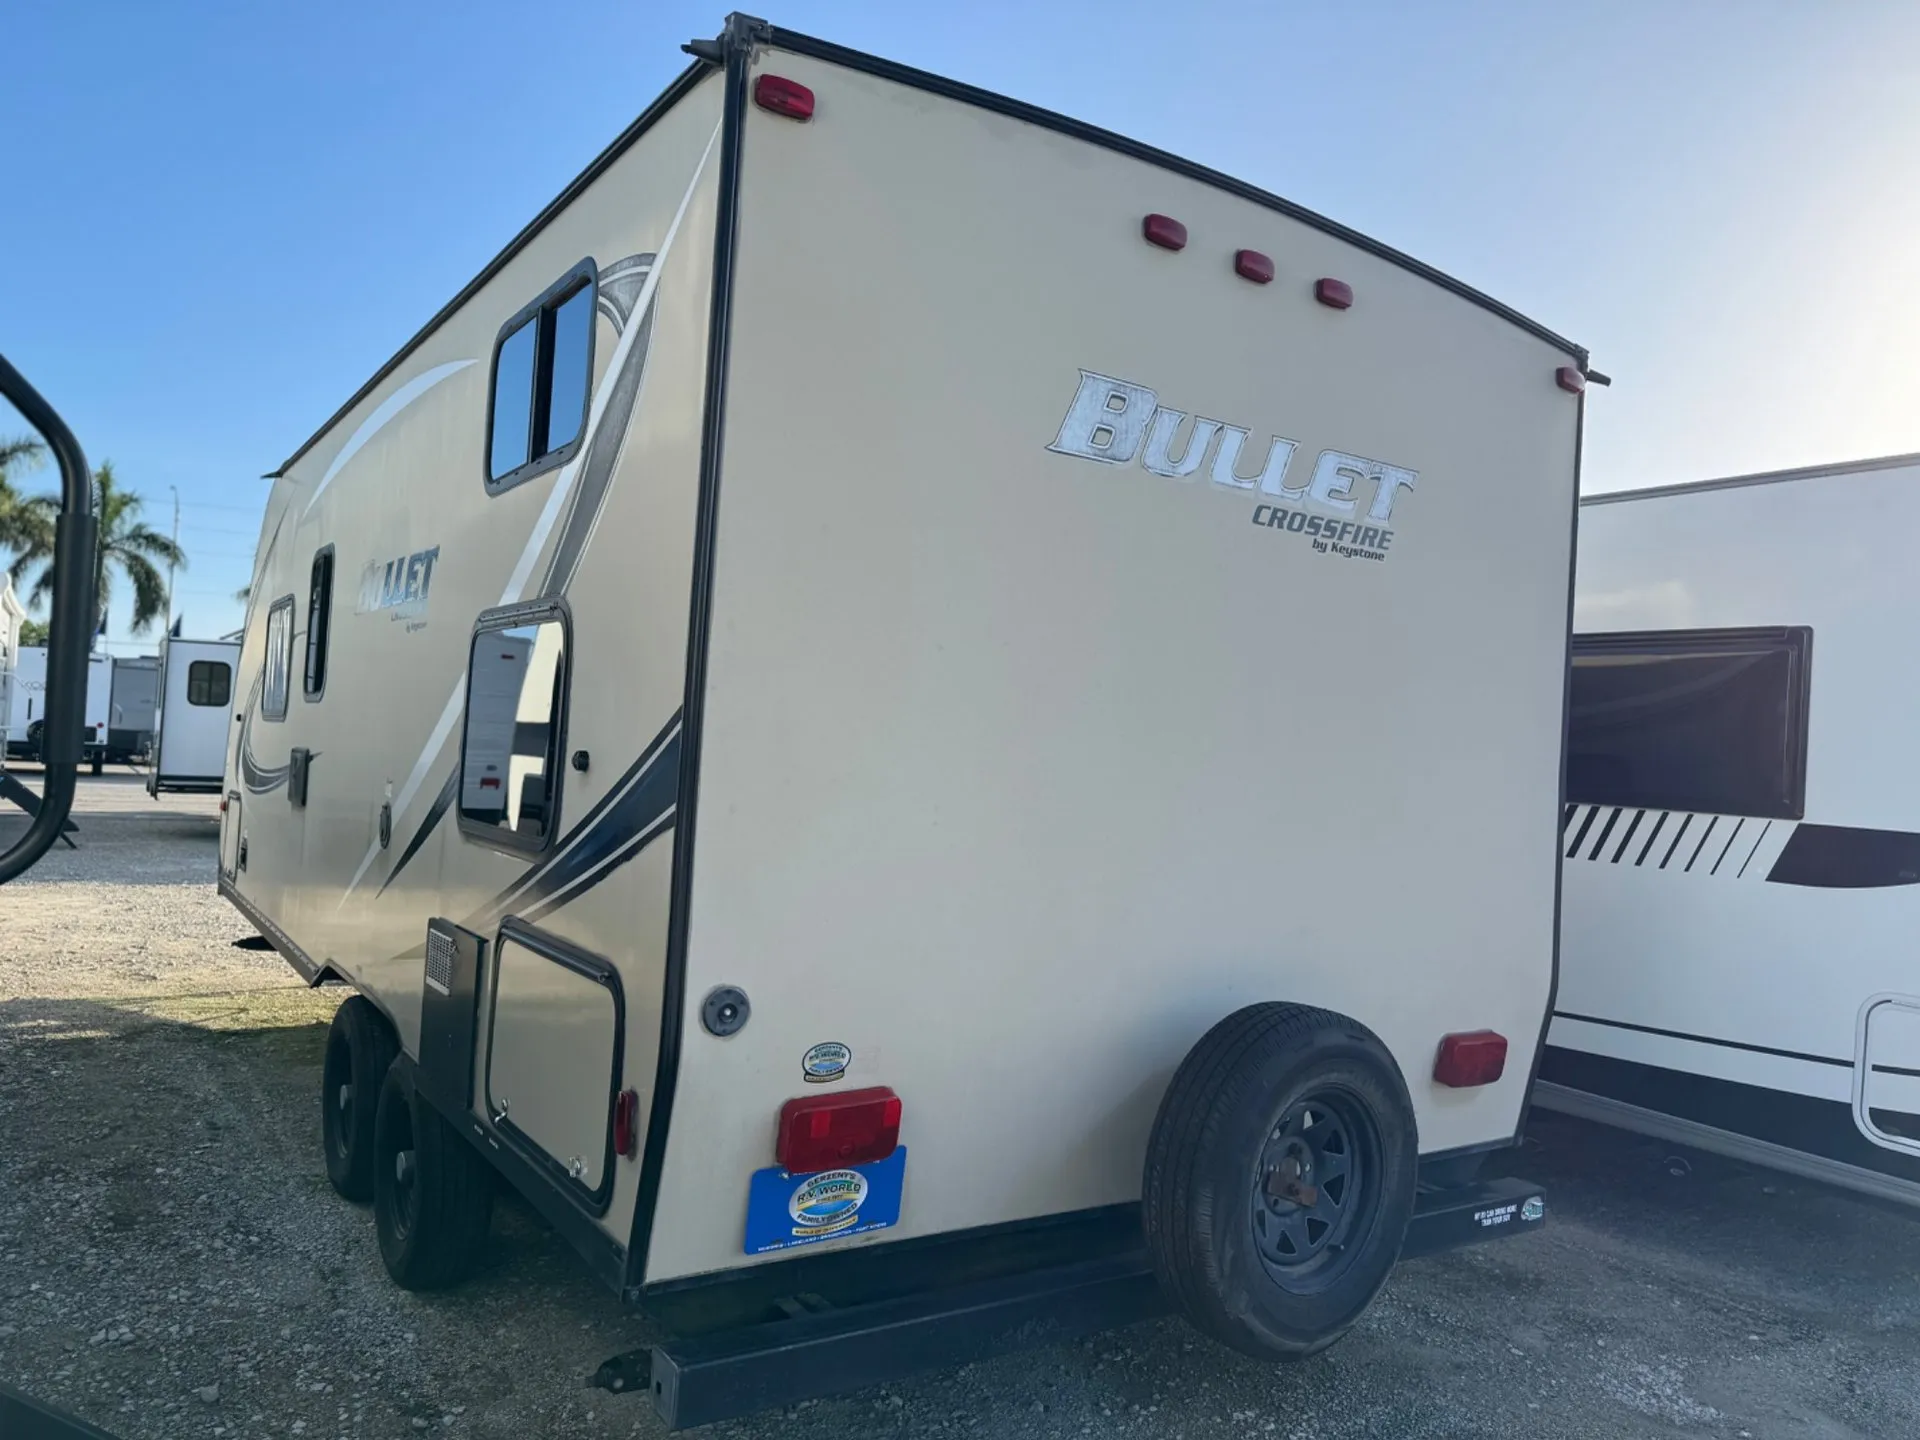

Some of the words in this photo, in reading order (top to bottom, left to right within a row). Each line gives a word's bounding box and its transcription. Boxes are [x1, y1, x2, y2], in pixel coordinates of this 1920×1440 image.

[1044, 368, 1420, 523] BULLET
[1252, 504, 1394, 550] CROSSFIRE
[1312, 538, 1328, 553] by
[1330, 541, 1385, 561] Keystone
[819, 1183, 862, 1195] WORLD
